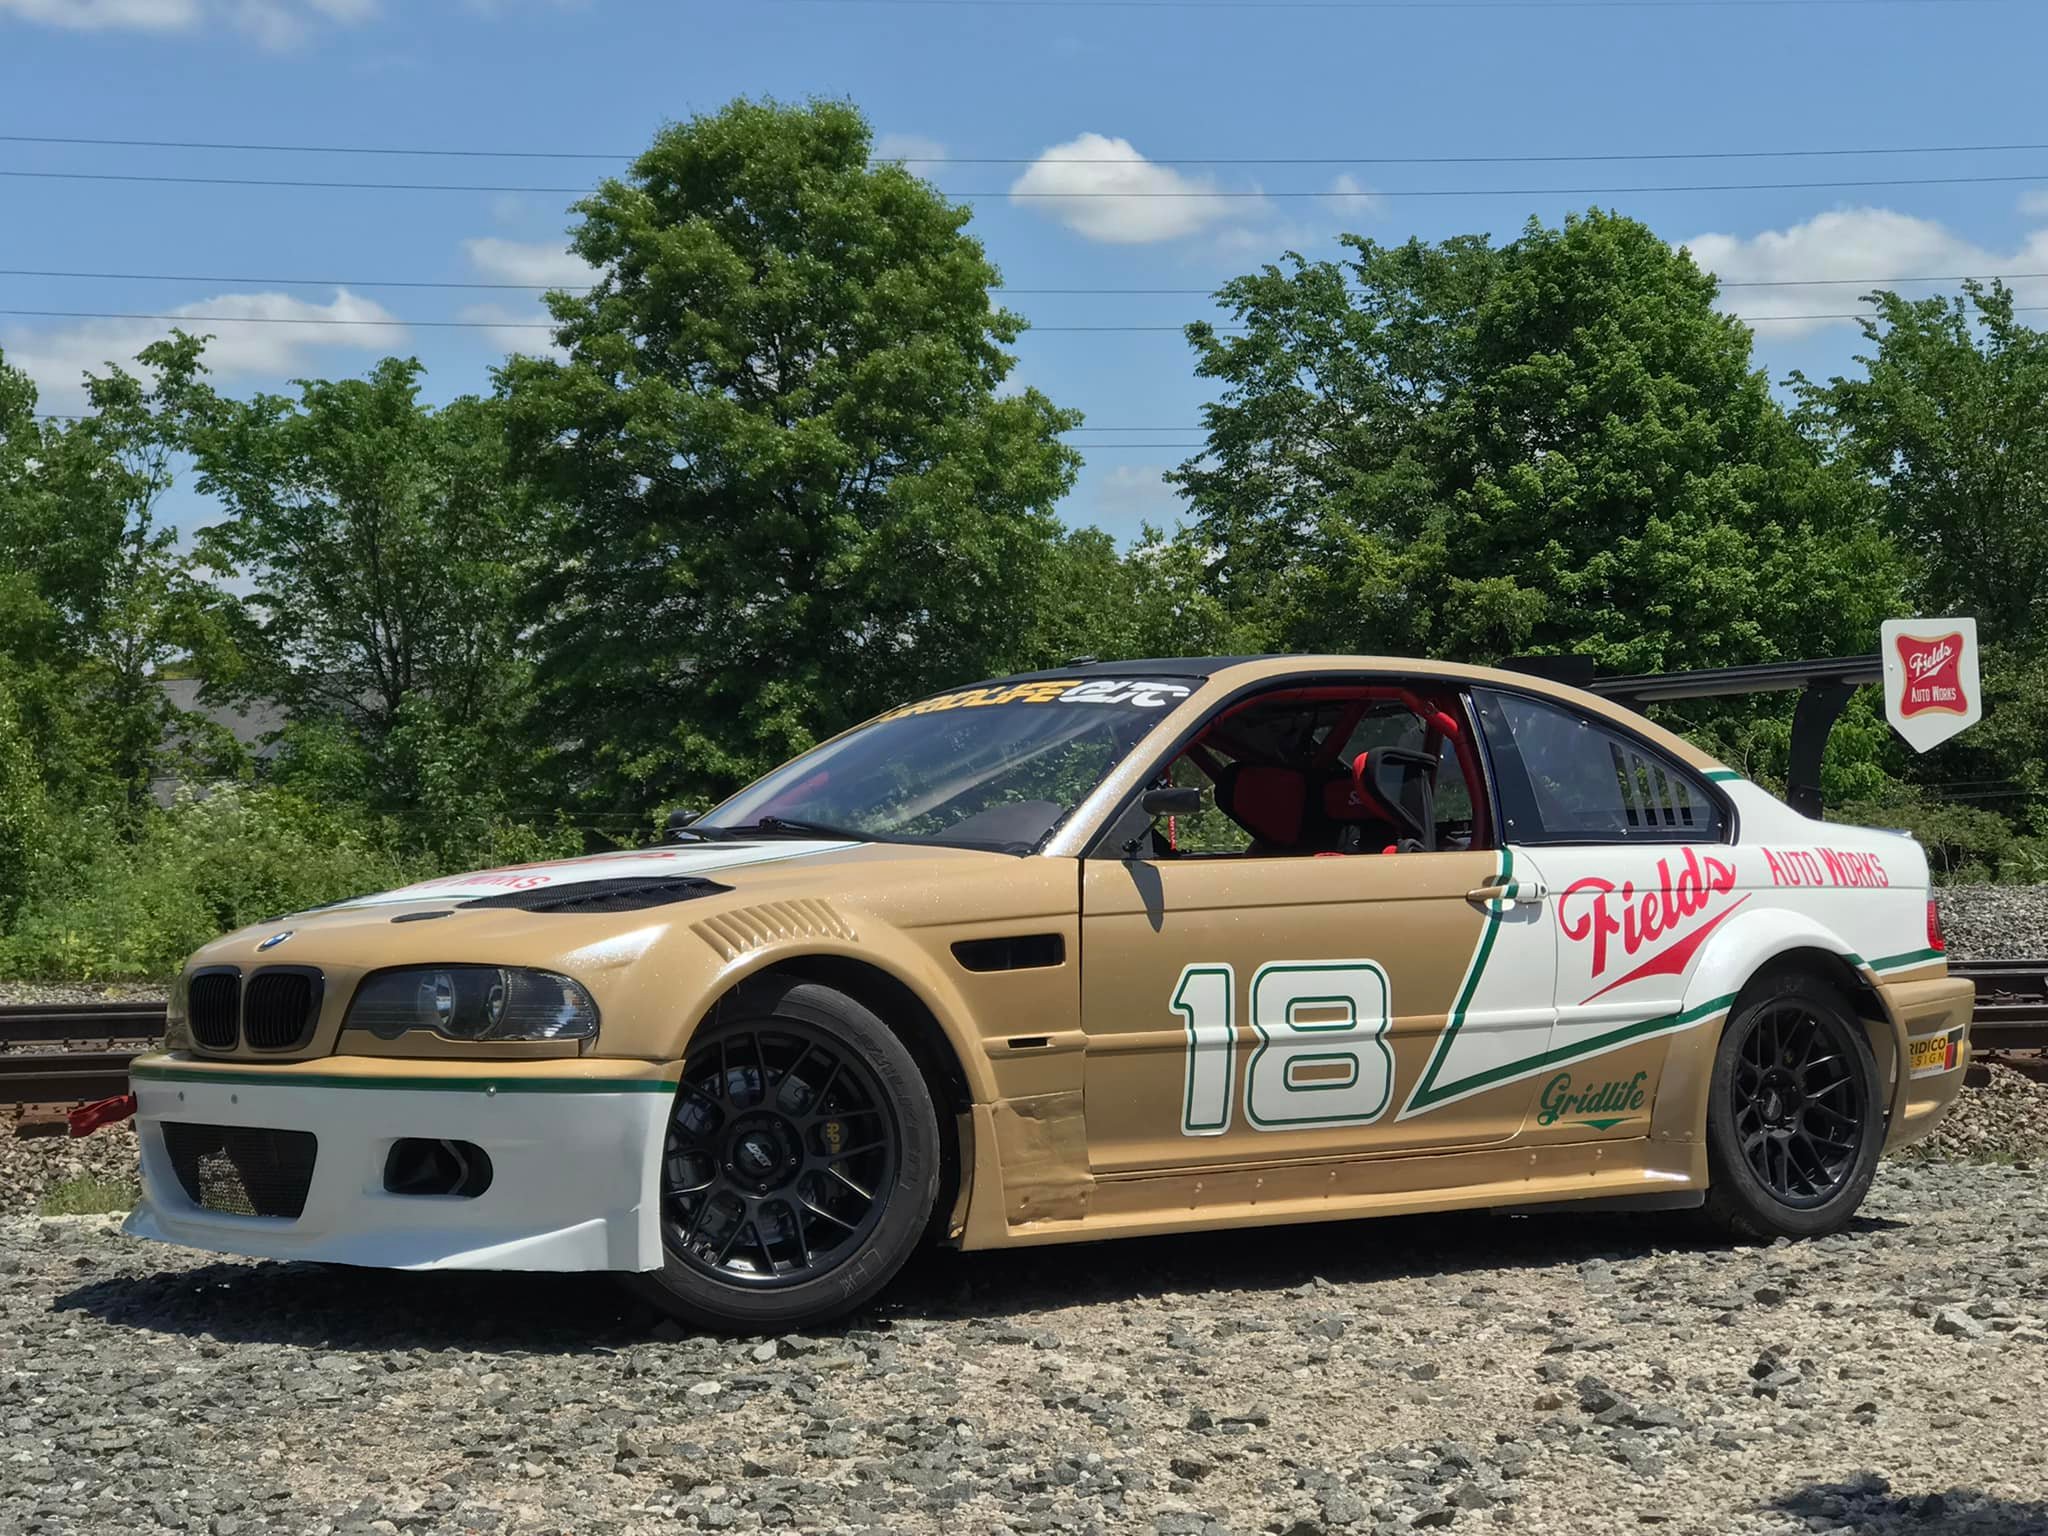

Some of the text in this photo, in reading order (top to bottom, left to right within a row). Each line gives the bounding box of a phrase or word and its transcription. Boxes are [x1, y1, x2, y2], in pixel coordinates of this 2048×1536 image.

[1909, 642, 1952, 677] Fields
[1911, 686, 1957, 703] AUTO WORKS
[1558, 847, 1889, 979] Fields AUTO WORKS
[1168, 958, 1396, 1137] 18
[1537, 1070, 1648, 1126] Gridlife
